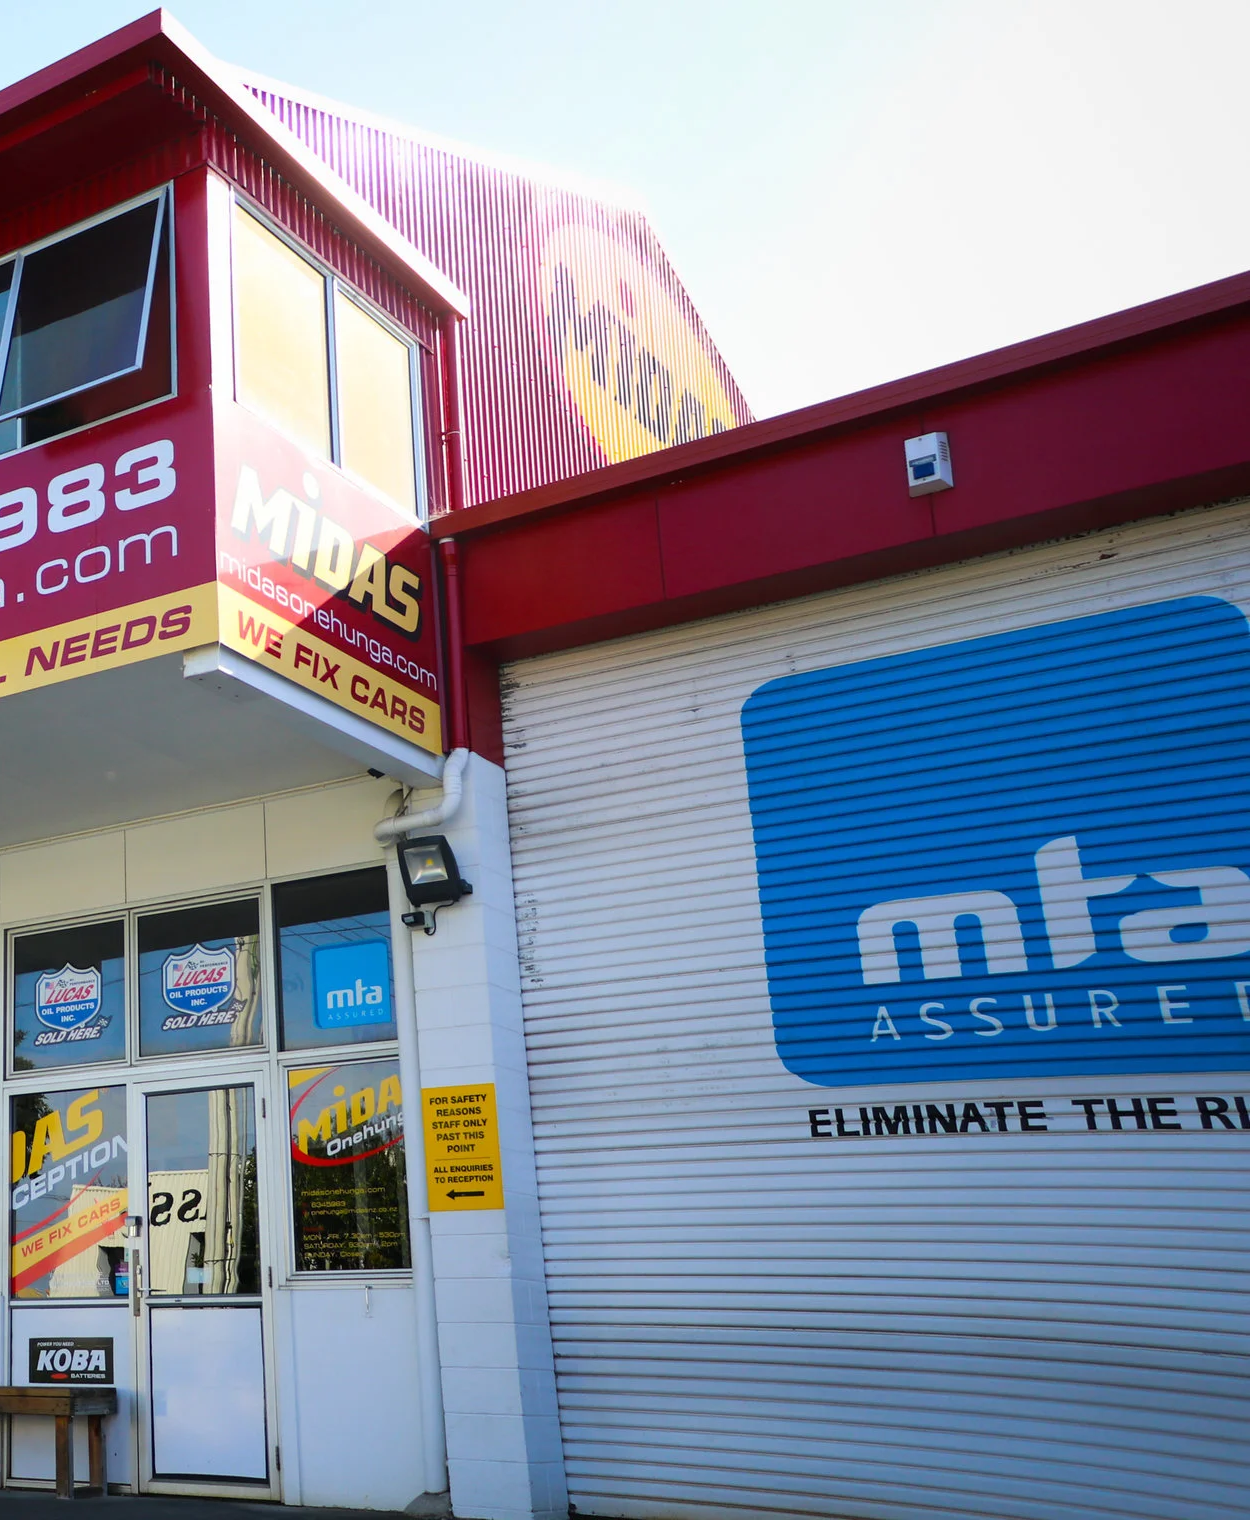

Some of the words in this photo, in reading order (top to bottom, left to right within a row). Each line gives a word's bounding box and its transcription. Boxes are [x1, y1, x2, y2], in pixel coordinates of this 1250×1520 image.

[220, 551, 437, 691] midasonehunga.com
[24, 604, 192, 676] NEEDS
[237, 610, 284, 659] WE
[294, 643, 341, 690] FIX
[351, 675, 426, 734] CARS
[857, 836, 1250, 985] mta
[173, 966, 227, 987] LUCAS
[45, 984, 94, 1004] LUCAS
[185, 985, 228, 997] PRODUCTS
[327, 979, 382, 1009] mta
[56, 1002, 95, 1013] PRODUCTS
[328, 1008, 384, 1020] ASSURED
[162, 1015, 197, 1030] SOLD
[35, 1030, 67, 1046] SOLD
[429, 1097, 448, 1105] FOR
[450, 1094, 487, 1104] SAFETY
[436, 1106, 482, 1117] REASONS
[807, 1100, 1048, 1138] ELIMINATE
[1071, 1097, 1181, 1131] THE
[432, 1120, 461, 1129] STAFF
[463, 1118, 488, 1128] ONLY
[326, 1112, 405, 1156] Onehung
[436, 1132, 461, 1141] PAST
[462, 1131, 485, 1139] THIS
[447, 1144, 476, 1153] POINT
[434, 1166, 448, 1174] ALL
[450, 1164, 494, 1173] ENQUIRIES
[435, 1176, 446, 1184] TO
[447, 1174, 494, 1183] RECEPTION
[21, 1237, 44, 1257] WE
[49, 1223, 73, 1244] FIX
[77, 1198, 121, 1228] CARS
[36, 1348, 106, 1372] KOBA
